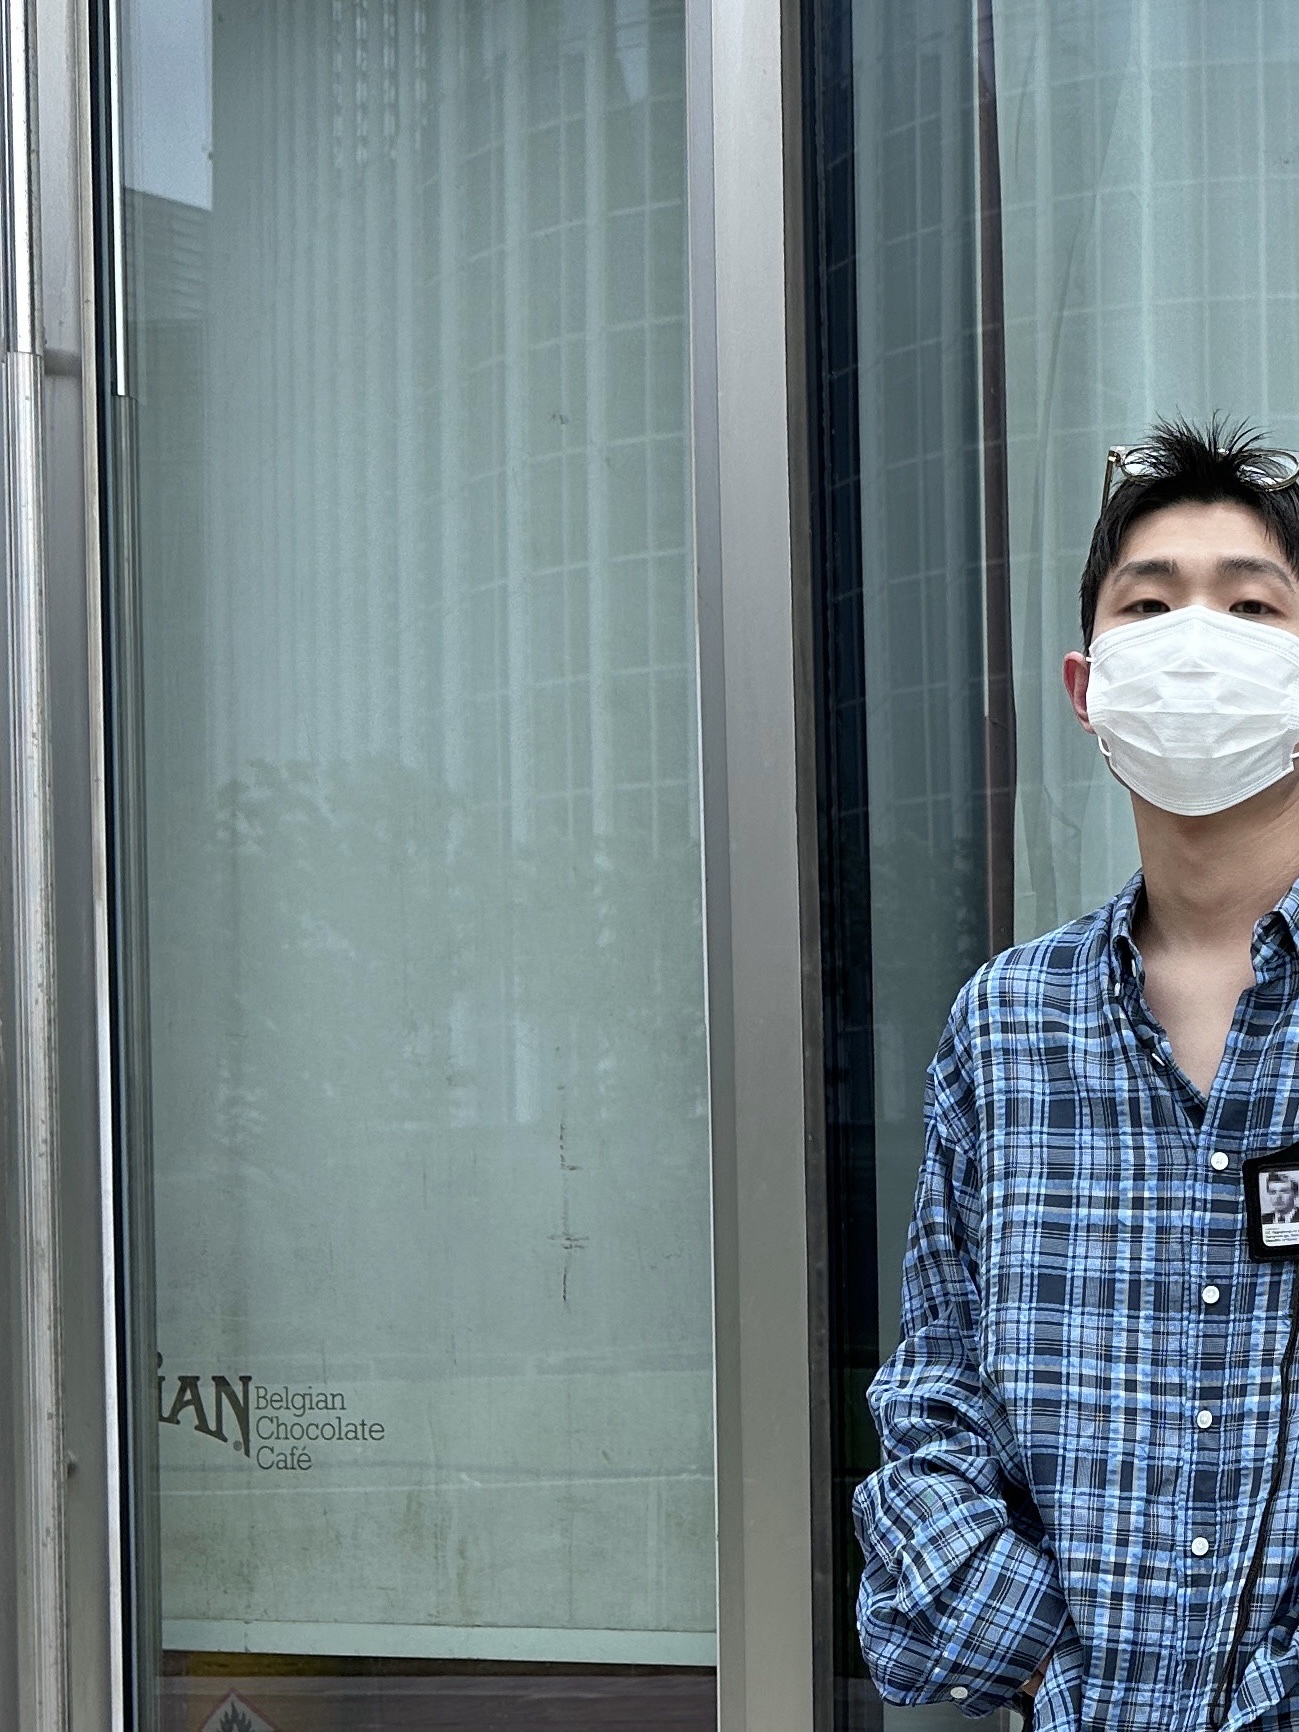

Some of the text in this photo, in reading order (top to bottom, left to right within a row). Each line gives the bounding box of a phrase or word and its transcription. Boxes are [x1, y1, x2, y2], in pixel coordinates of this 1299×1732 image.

[255, 1385, 347, 1417] Belgian
[256, 1415, 385, 1441] Chocolate
[256, 1445, 313, 1471] Café
